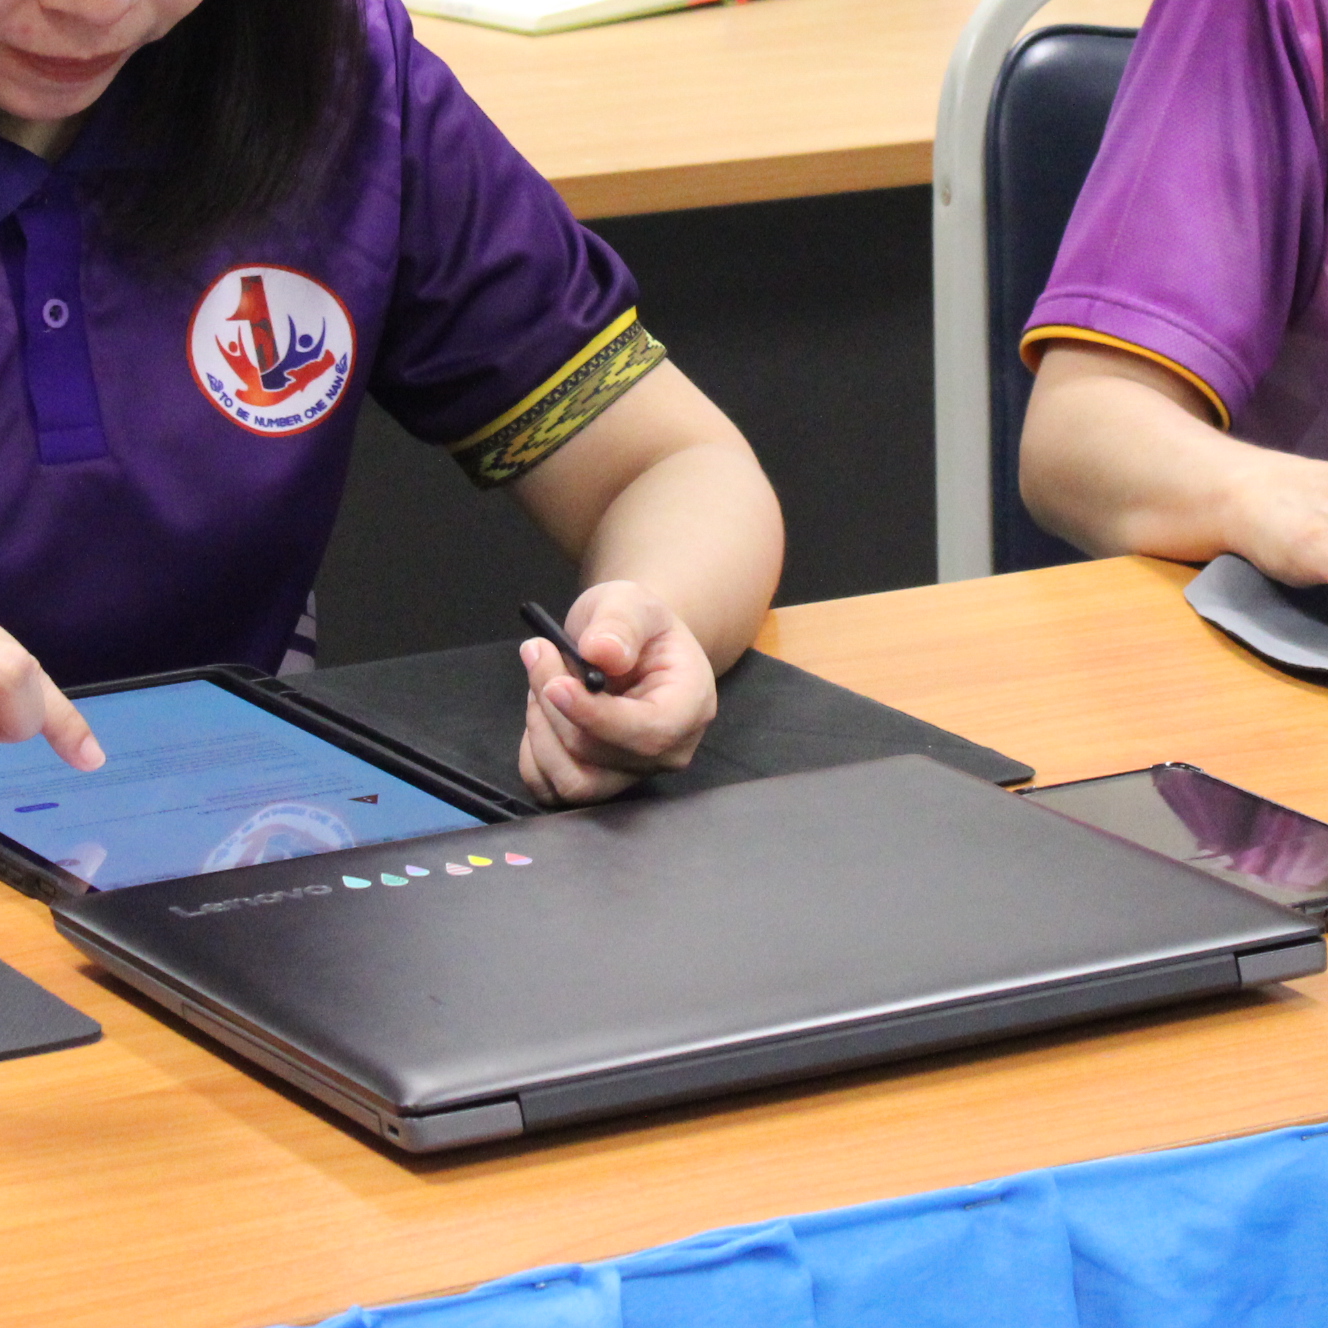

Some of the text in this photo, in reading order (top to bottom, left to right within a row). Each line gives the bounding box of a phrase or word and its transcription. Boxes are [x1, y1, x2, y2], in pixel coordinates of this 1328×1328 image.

[219, 375, 345, 428] TO BE NUMBER ONE NAN
